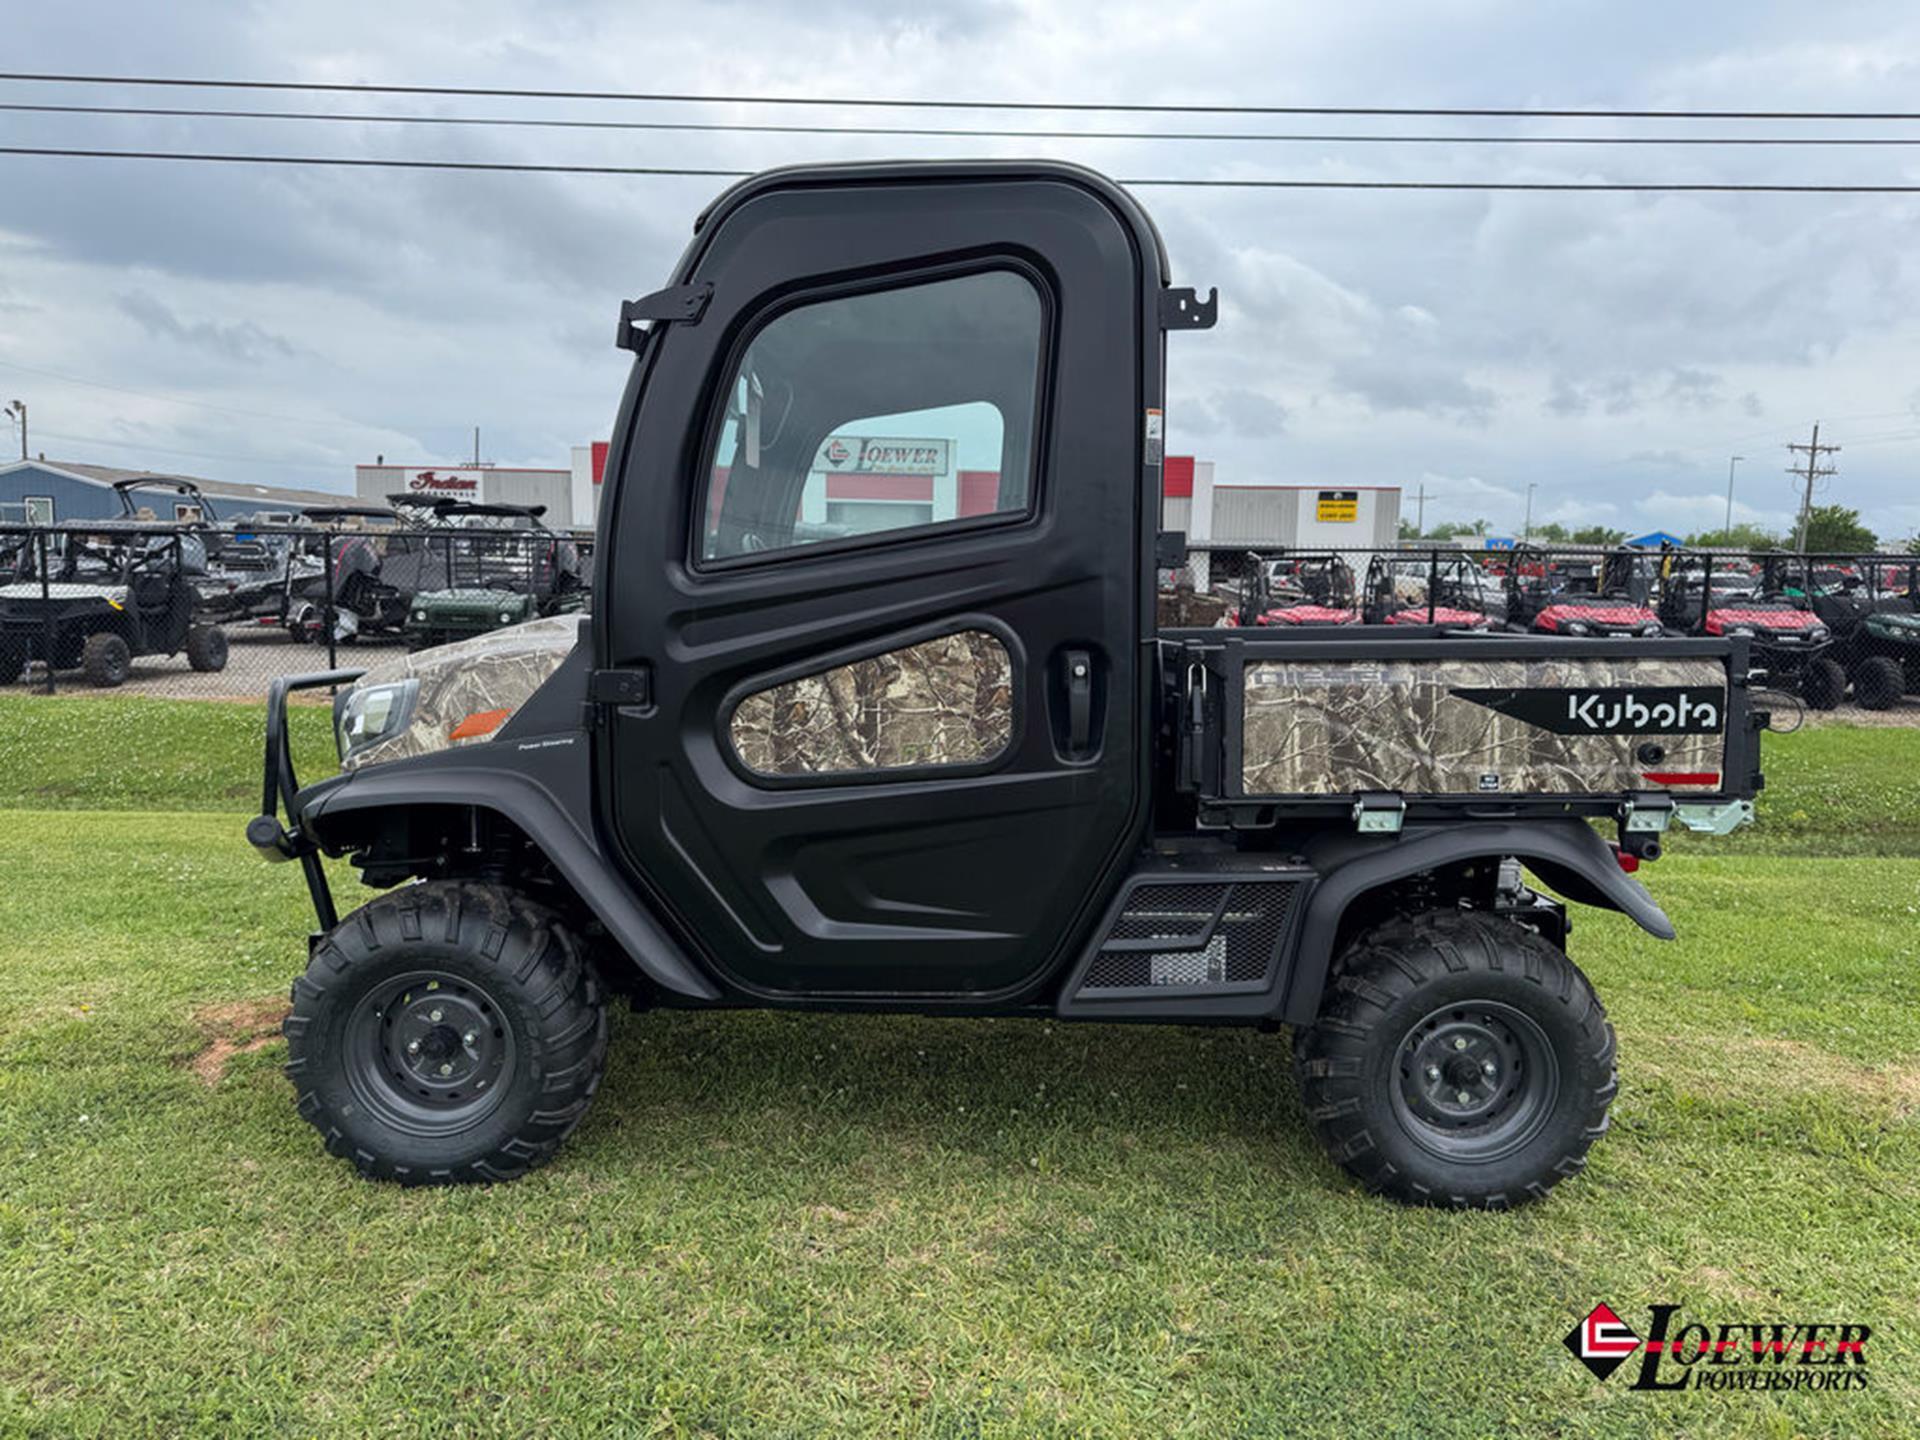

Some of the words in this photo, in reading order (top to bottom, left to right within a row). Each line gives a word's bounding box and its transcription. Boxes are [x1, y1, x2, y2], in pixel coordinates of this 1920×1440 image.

[855, 440, 938, 472] LOEWER
[410, 471, 478, 490] Indian
[1568, 694, 1717, 728] Kubota
[518, 743, 541, 751] Power
[542, 738, 574, 748] Steering
